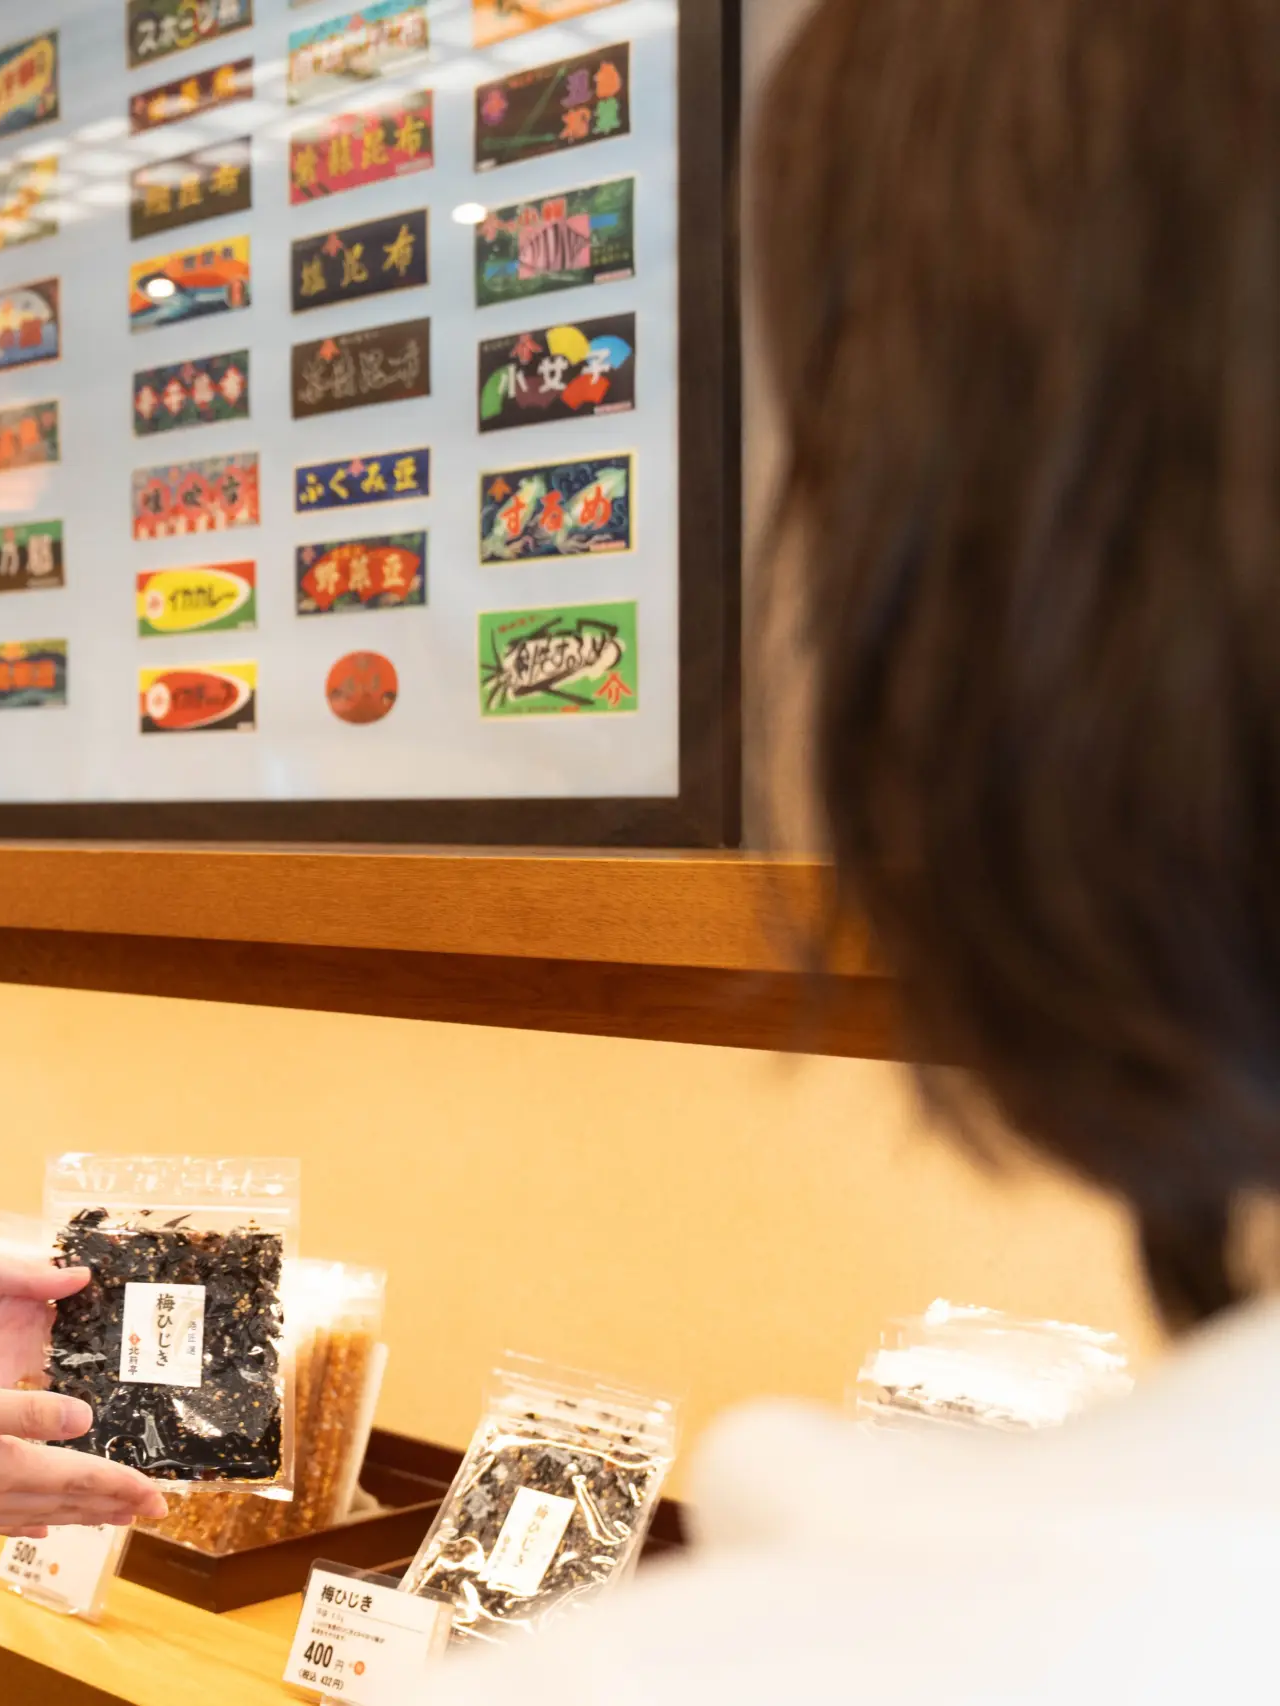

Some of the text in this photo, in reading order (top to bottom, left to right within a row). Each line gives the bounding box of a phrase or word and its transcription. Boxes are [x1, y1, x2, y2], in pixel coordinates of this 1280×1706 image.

[498, 348, 612, 399] 小女子
[299, 456, 418, 505] ふくみ豆
[500, 484, 613, 539] するめ
[314, 553, 406, 595] 野菜豆
[156, 1293, 176, 1367] 梅ひじき
[321, 1584, 373, 1613] 梅ひじき
[304, 1640, 333, 1668] 400
